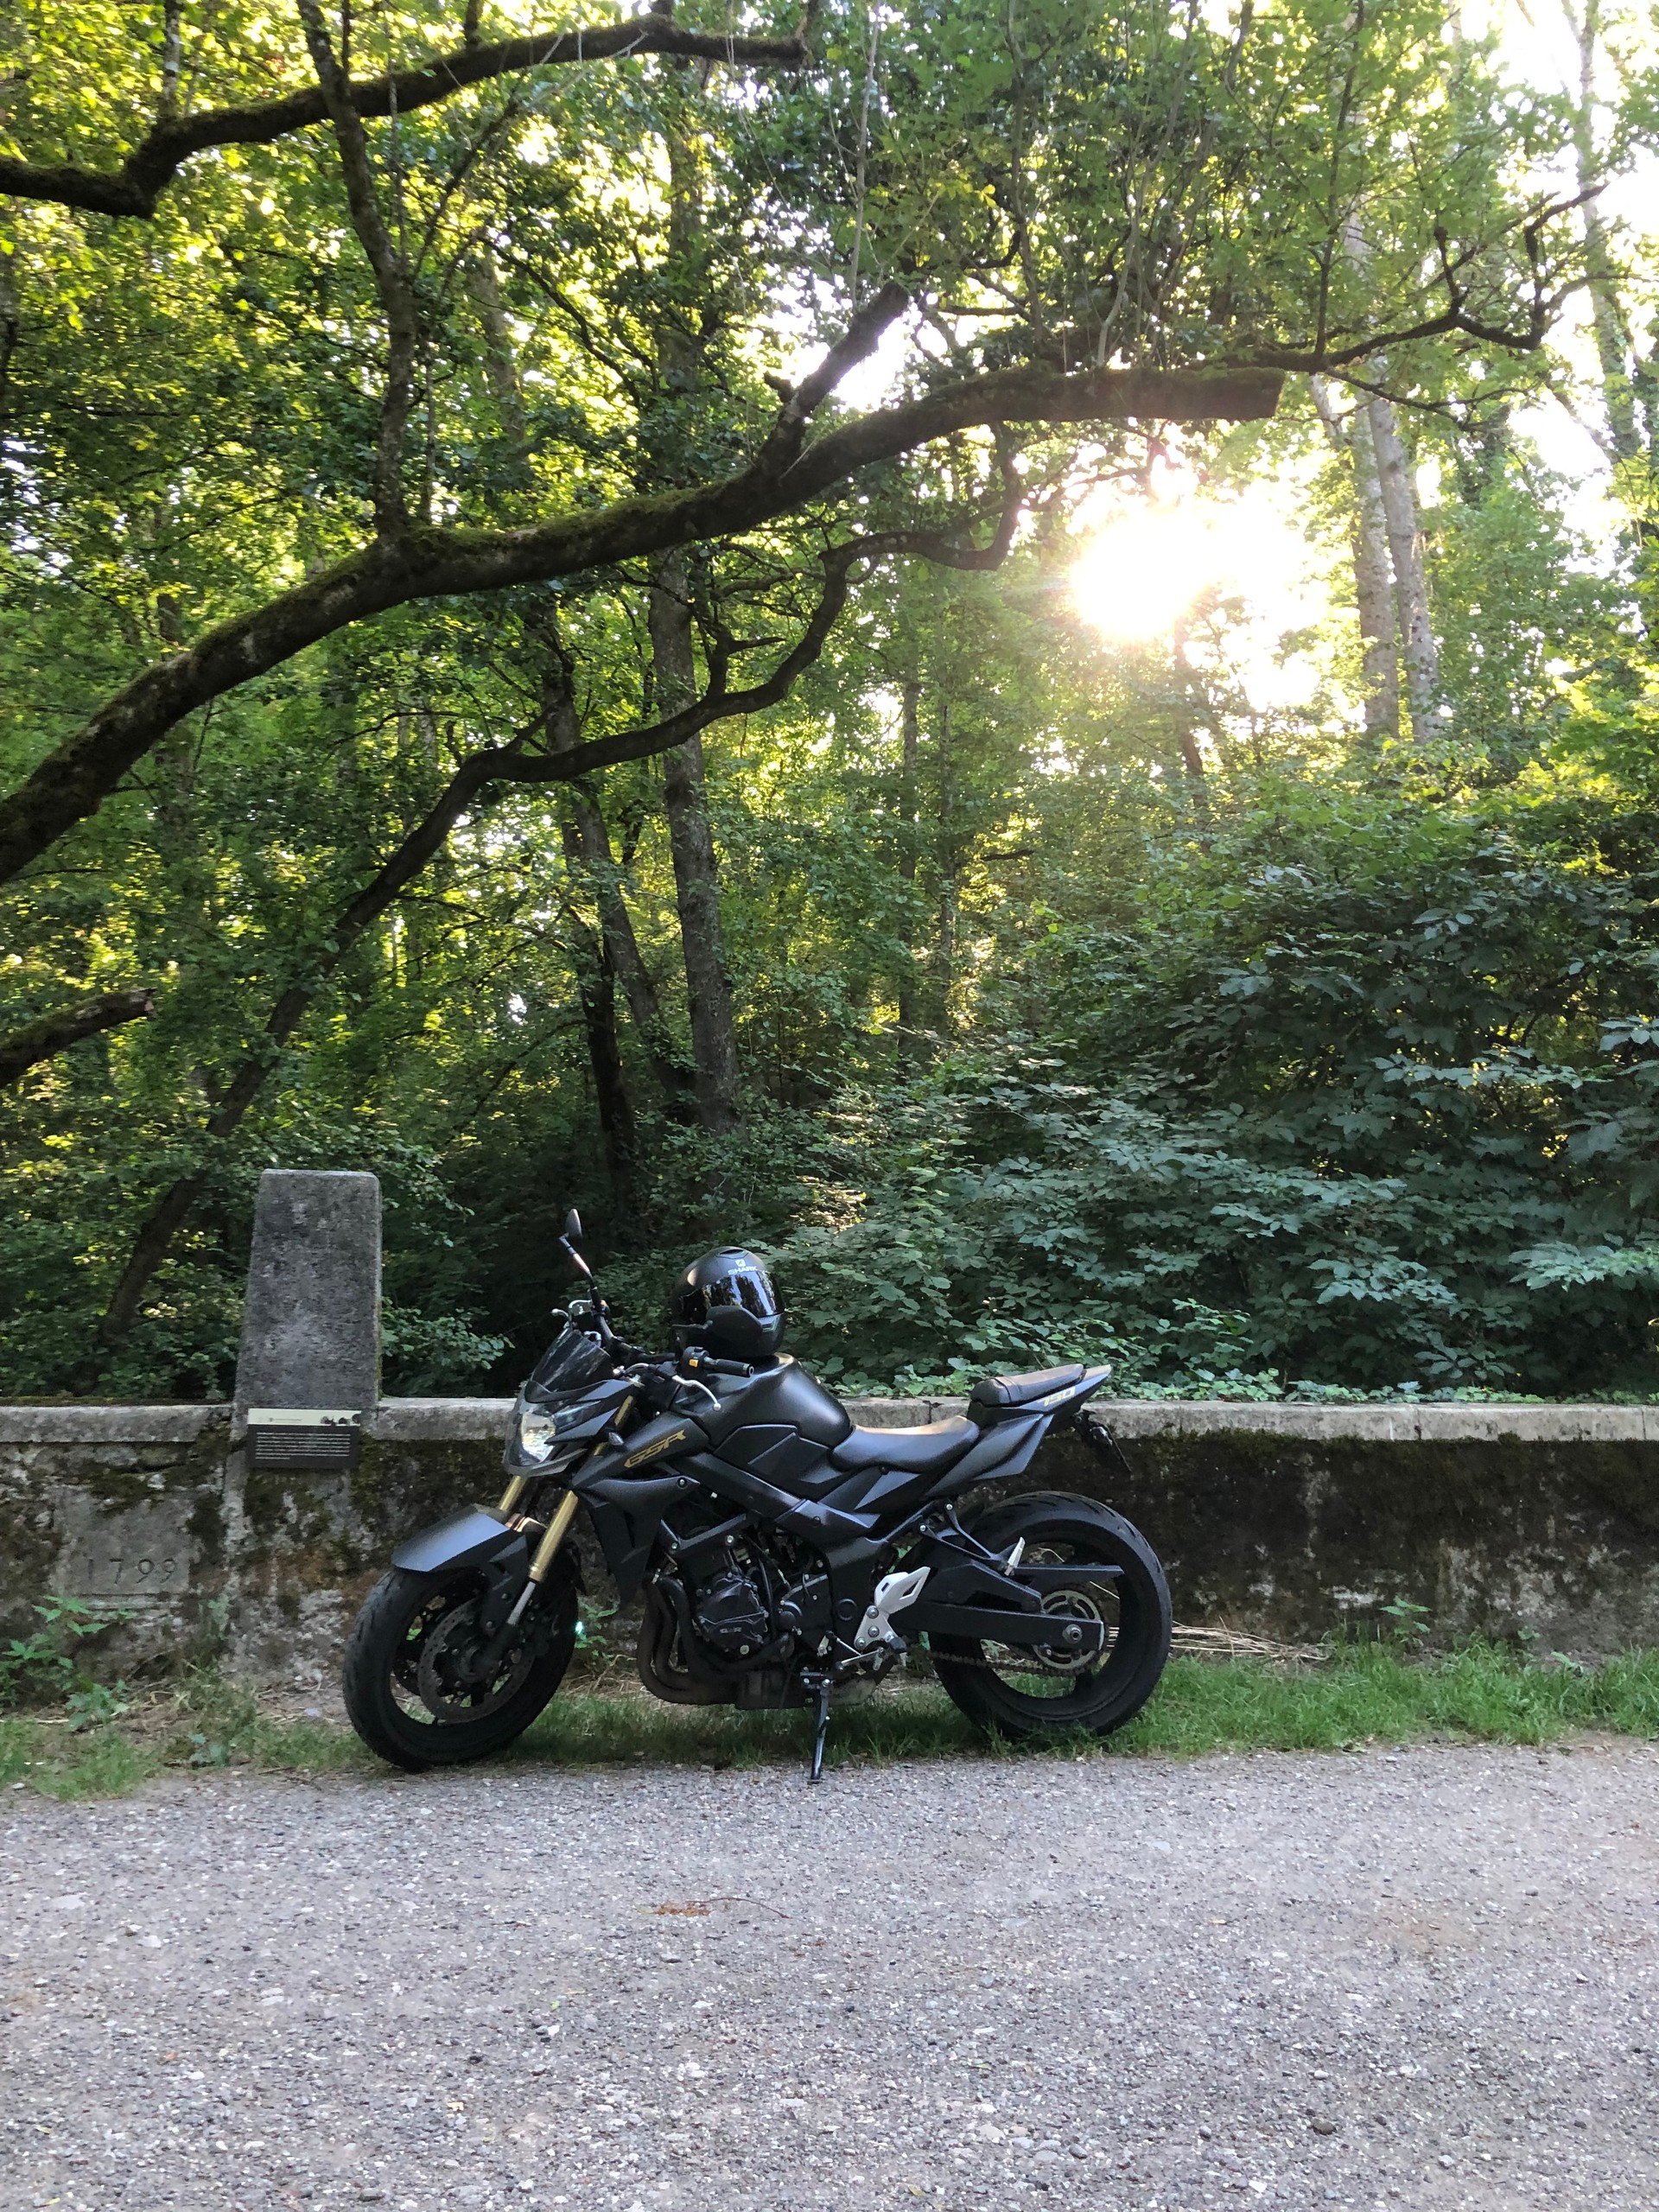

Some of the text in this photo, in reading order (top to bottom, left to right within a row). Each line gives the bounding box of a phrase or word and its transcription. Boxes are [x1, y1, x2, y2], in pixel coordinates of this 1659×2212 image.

[728, 1266, 758, 1275] SHARK
[624, 1429, 686, 1468] GSR
[88, 1557, 176, 1585] 1799
